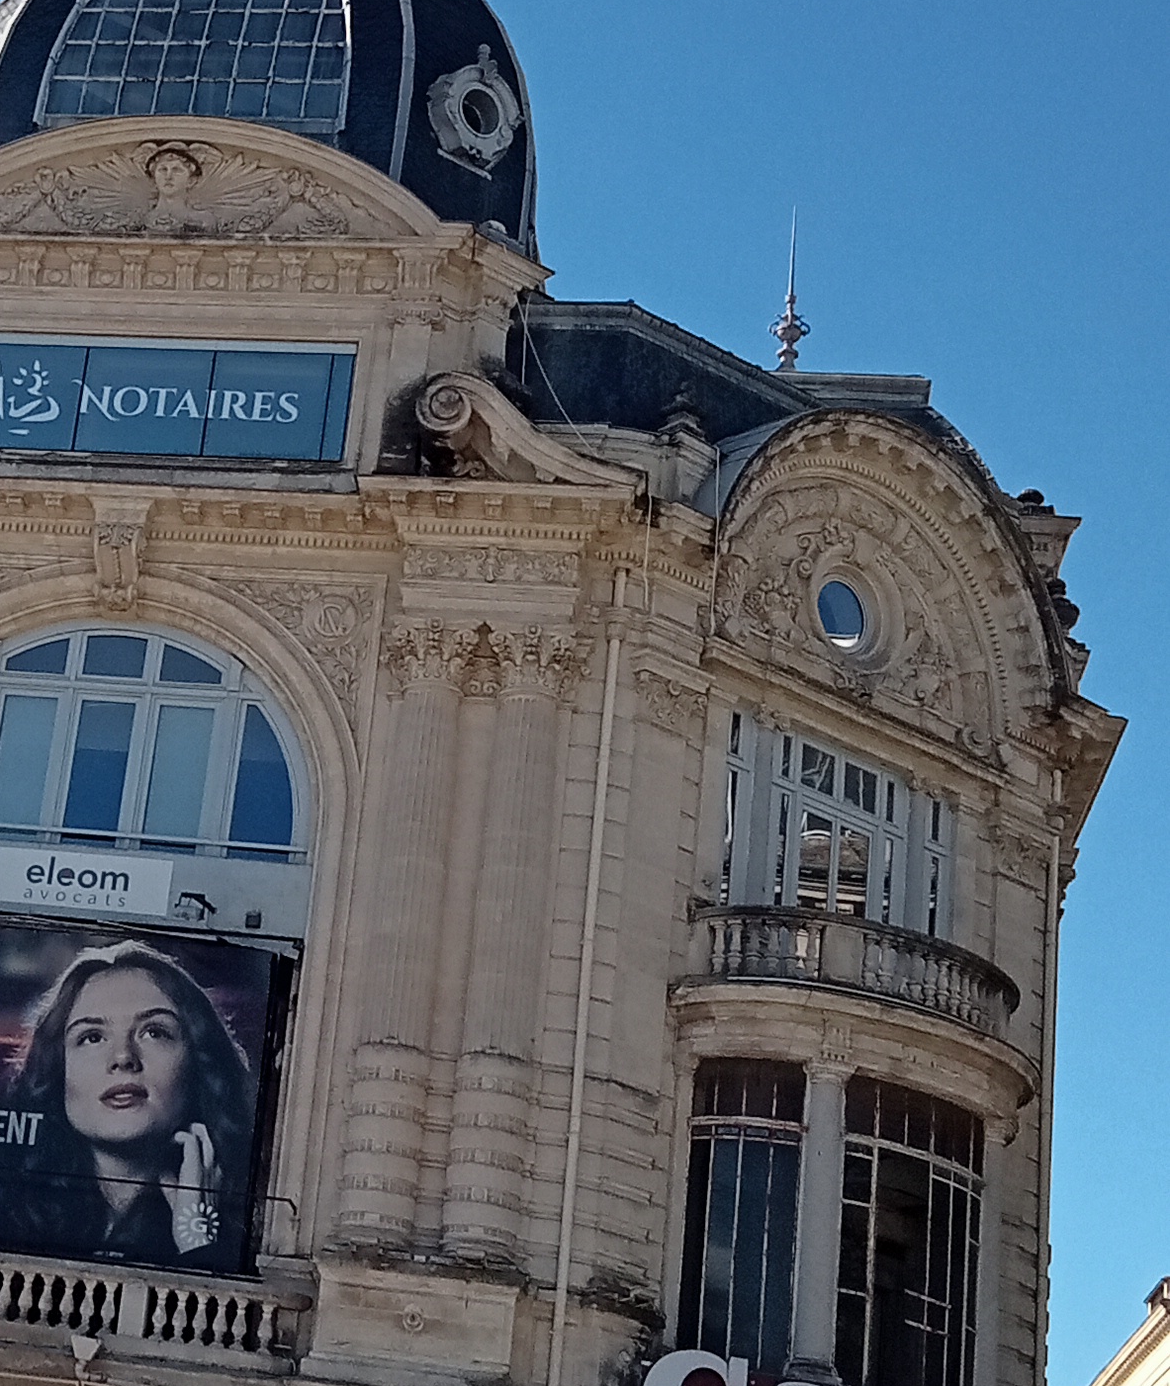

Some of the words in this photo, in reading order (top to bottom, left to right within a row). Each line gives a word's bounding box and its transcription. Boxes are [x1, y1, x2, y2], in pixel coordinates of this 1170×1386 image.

[71, 379, 299, 423] NOTAIRES
[26, 856, 130, 892] eleom
[23, 888, 126, 907] avocats
